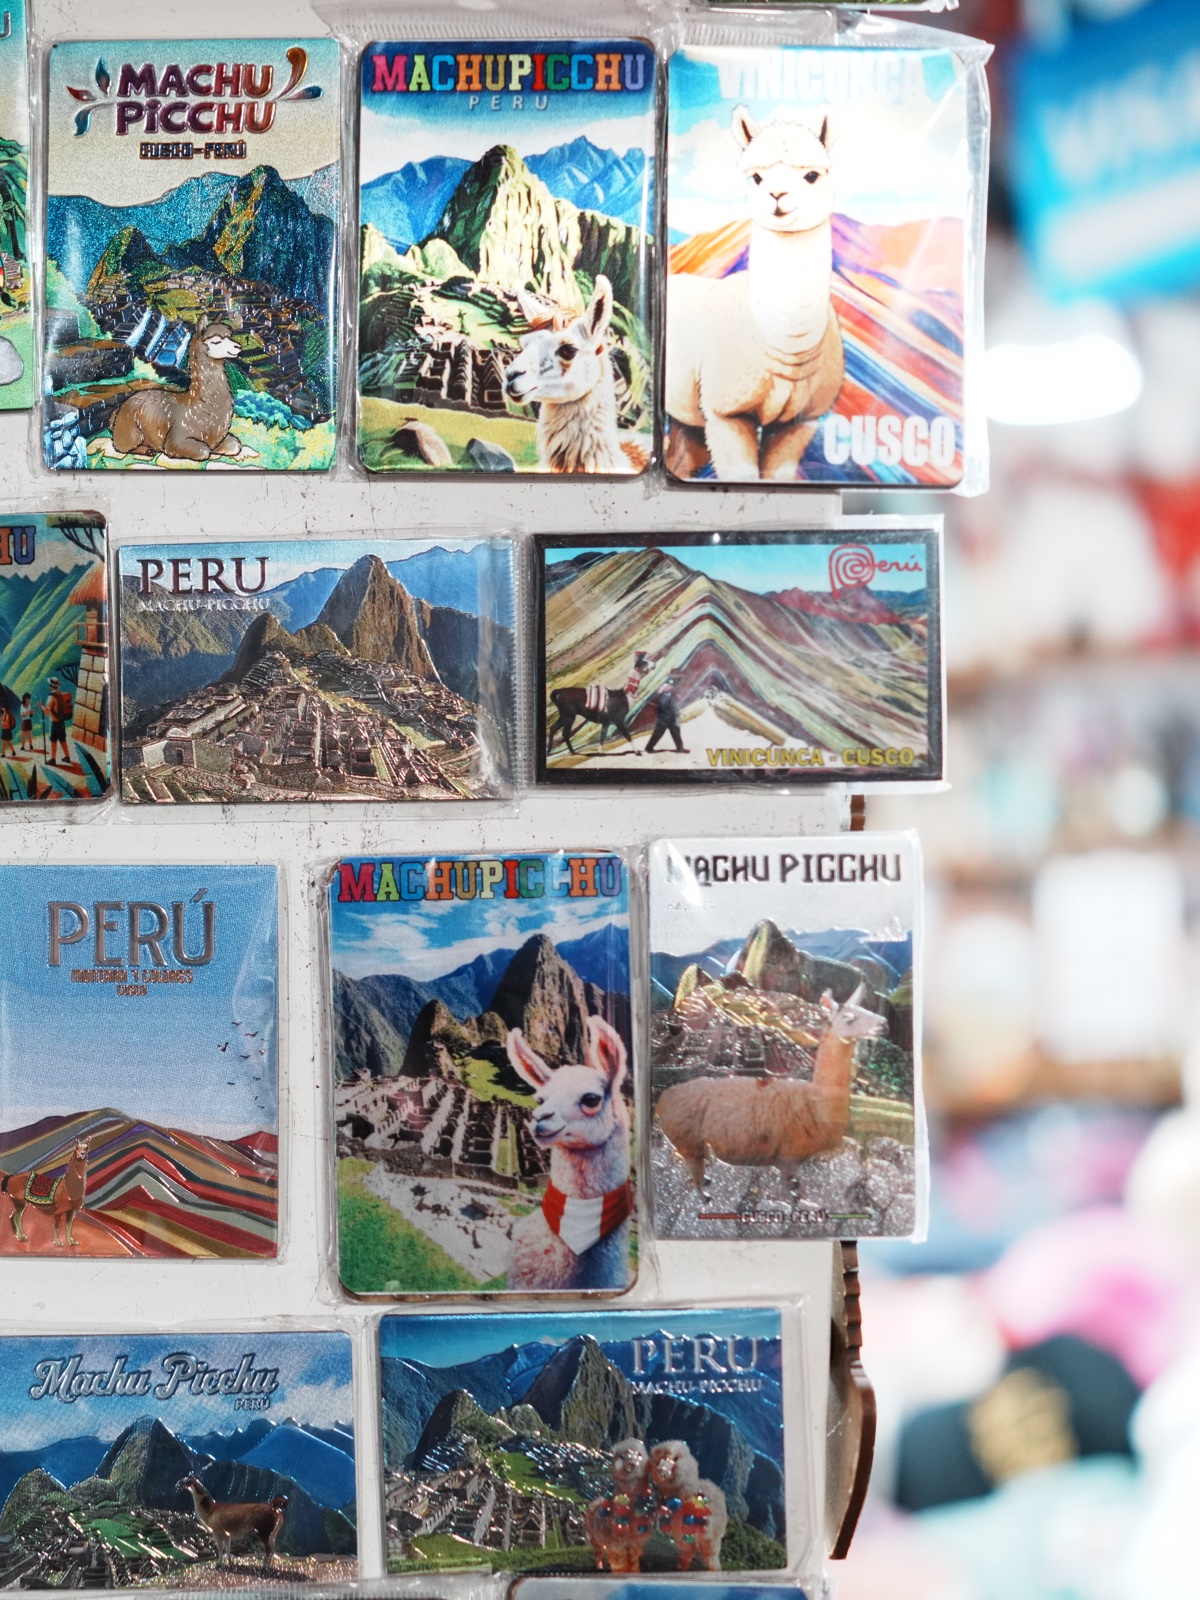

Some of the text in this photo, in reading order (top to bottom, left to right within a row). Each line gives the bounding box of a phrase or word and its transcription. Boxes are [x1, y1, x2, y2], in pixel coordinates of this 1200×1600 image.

[117, 63, 274, 98] MACHU
[372, 53, 647, 93] MACHUPICCHU
[469, 95, 548, 111] PERU
[824, 415, 956, 467] CUSCO
[137, 557, 271, 596] PERU
[705, 748, 823, 767] VINICUNCA
[842, 747, 915, 767] CUSCO
[337, 857, 622, 902] MACHUPICCHU
[48, 887, 216, 967] PERÚ
[632, 1336, 758, 1375] PERU
[29, 1351, 279, 1402] Machu Picchu
